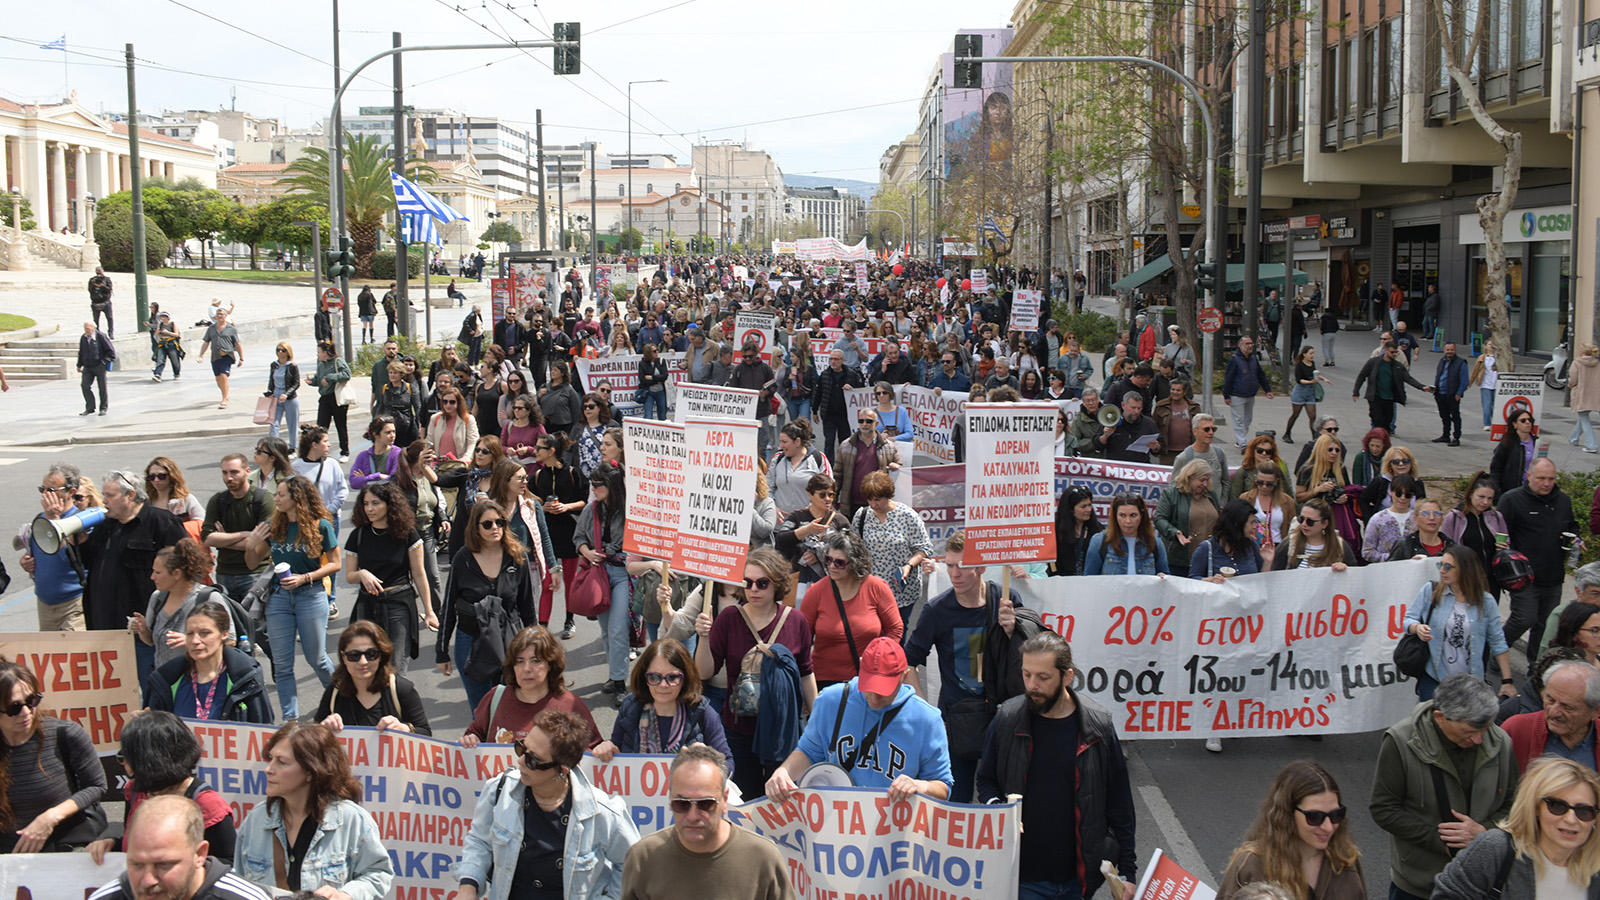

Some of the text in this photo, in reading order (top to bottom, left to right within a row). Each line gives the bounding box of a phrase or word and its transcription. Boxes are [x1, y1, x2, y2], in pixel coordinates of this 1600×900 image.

[1330, 217, 1346, 228] COFFEE
[1338, 228, 1354, 238] ISLAND
[590, 362, 622, 372] ΔΩΡΕΑΝ
[624, 360, 638, 371] ΠΑΙ
[614, 393, 634, 402] ΕΛΛΑ
[683, 390, 753, 404] ΜΕΙΩΣΗ ΤΟΥ ΩΡΑΡΙΟΥ
[902, 391, 967, 414] ΕΠΑΝΑΦΟ
[688, 402, 745, 415] ΤΩΝ ΝΗΠΙΑΓΩΓΩΝ
[970, 417, 1010, 432] ΕΠΙΔΟΜΑ
[1013, 416, 1054, 432] ΣΤΕΓΑΣΗΣ
[629, 426, 686, 444] ΠΑΡΑΛΛΗΛΗ ΣΤΗ
[706, 431, 734, 447] ΛΕΦΤΑ
[926, 430, 950, 446] ΤΩΝ
[634, 441, 643, 451] ΓΙΑ
[645, 442, 658, 453] ΟΛΑ
[661, 445, 670, 454] ΤΑ
[995, 441, 1029, 454] ΔΩΡΕΑΝ
[646, 457, 682, 471] ΣΤΕΛΕΧΩΣΗ
[688, 451, 753, 471] ΓΙΑ ΤΑ ΣΧΟΛΕΙΑ
[984, 462, 1040, 476] ΚΑΤΑΛΥΜΑΤΑ
[630, 467, 685, 485] ΤΩΝ ΕΙΔΙΚΩΝ ΣΧΟΛ
[702, 473, 732, 491] ΚΑΙ ΟΧΙ
[1105, 466, 1172, 482] ΜΙΣΘΟΥ
[639, 482, 684, 497] ΜΕ ΤΟ ΑΝΑΓΚΑ
[972, 482, 1048, 498] ΓΙΑ ΑΝΑΠΛΗΡΩΤΕΣ
[636, 495, 680, 511] ΕΚΠΑΙΔΕΥΤΙΚΟ
[689, 493, 744, 515] ΓΙΑ ΤΟΥ ΝΑΤΟ
[664, 512, 680, 524] ΠΡΟΣ
[918, 509, 946, 521] ΟΧΙ
[969, 503, 1050, 520] ΚΑΙ ΝΕΟΔΙΟΡΙΣΤΟΥΣ
[689, 515, 738, 536] ΤΑ ΣΦΑΓΕΙΑ
[968, 529, 996, 539] ΣΥΛΛΟΓΟΣ
[998, 526, 1040, 537] ΕΚΠΑΙΔΕΥΤΙΚΩΝ
[678, 536, 697, 547] ΣΥΛΛΟΓΟΣ
[1103, 605, 1176, 646] 20%
[1198, 614, 1263, 645] στον
[1285, 594, 1368, 646] μισθό
[1124, 700, 1193, 732] ΣΕΠΕ
[837, 734, 906, 780] GAP
[378, 734, 470, 780] ΠΑΙΔΕΙΑ
[475, 754, 513, 781] ΚΑΙ
[592, 764, 630, 796] ΚΑΙ
[640, 761, 671, 797] ΟΧ
[402, 781, 462, 809] ΑΠΟ
[756, 792, 824, 833] ΝΑΤΟ
[833, 800, 866, 836] ΤΑ
[874, 797, 1006, 850] ΣΦΑΓΕΙΑ!
[812, 841, 984, 890] ΠΟΛΕΜΟ!
